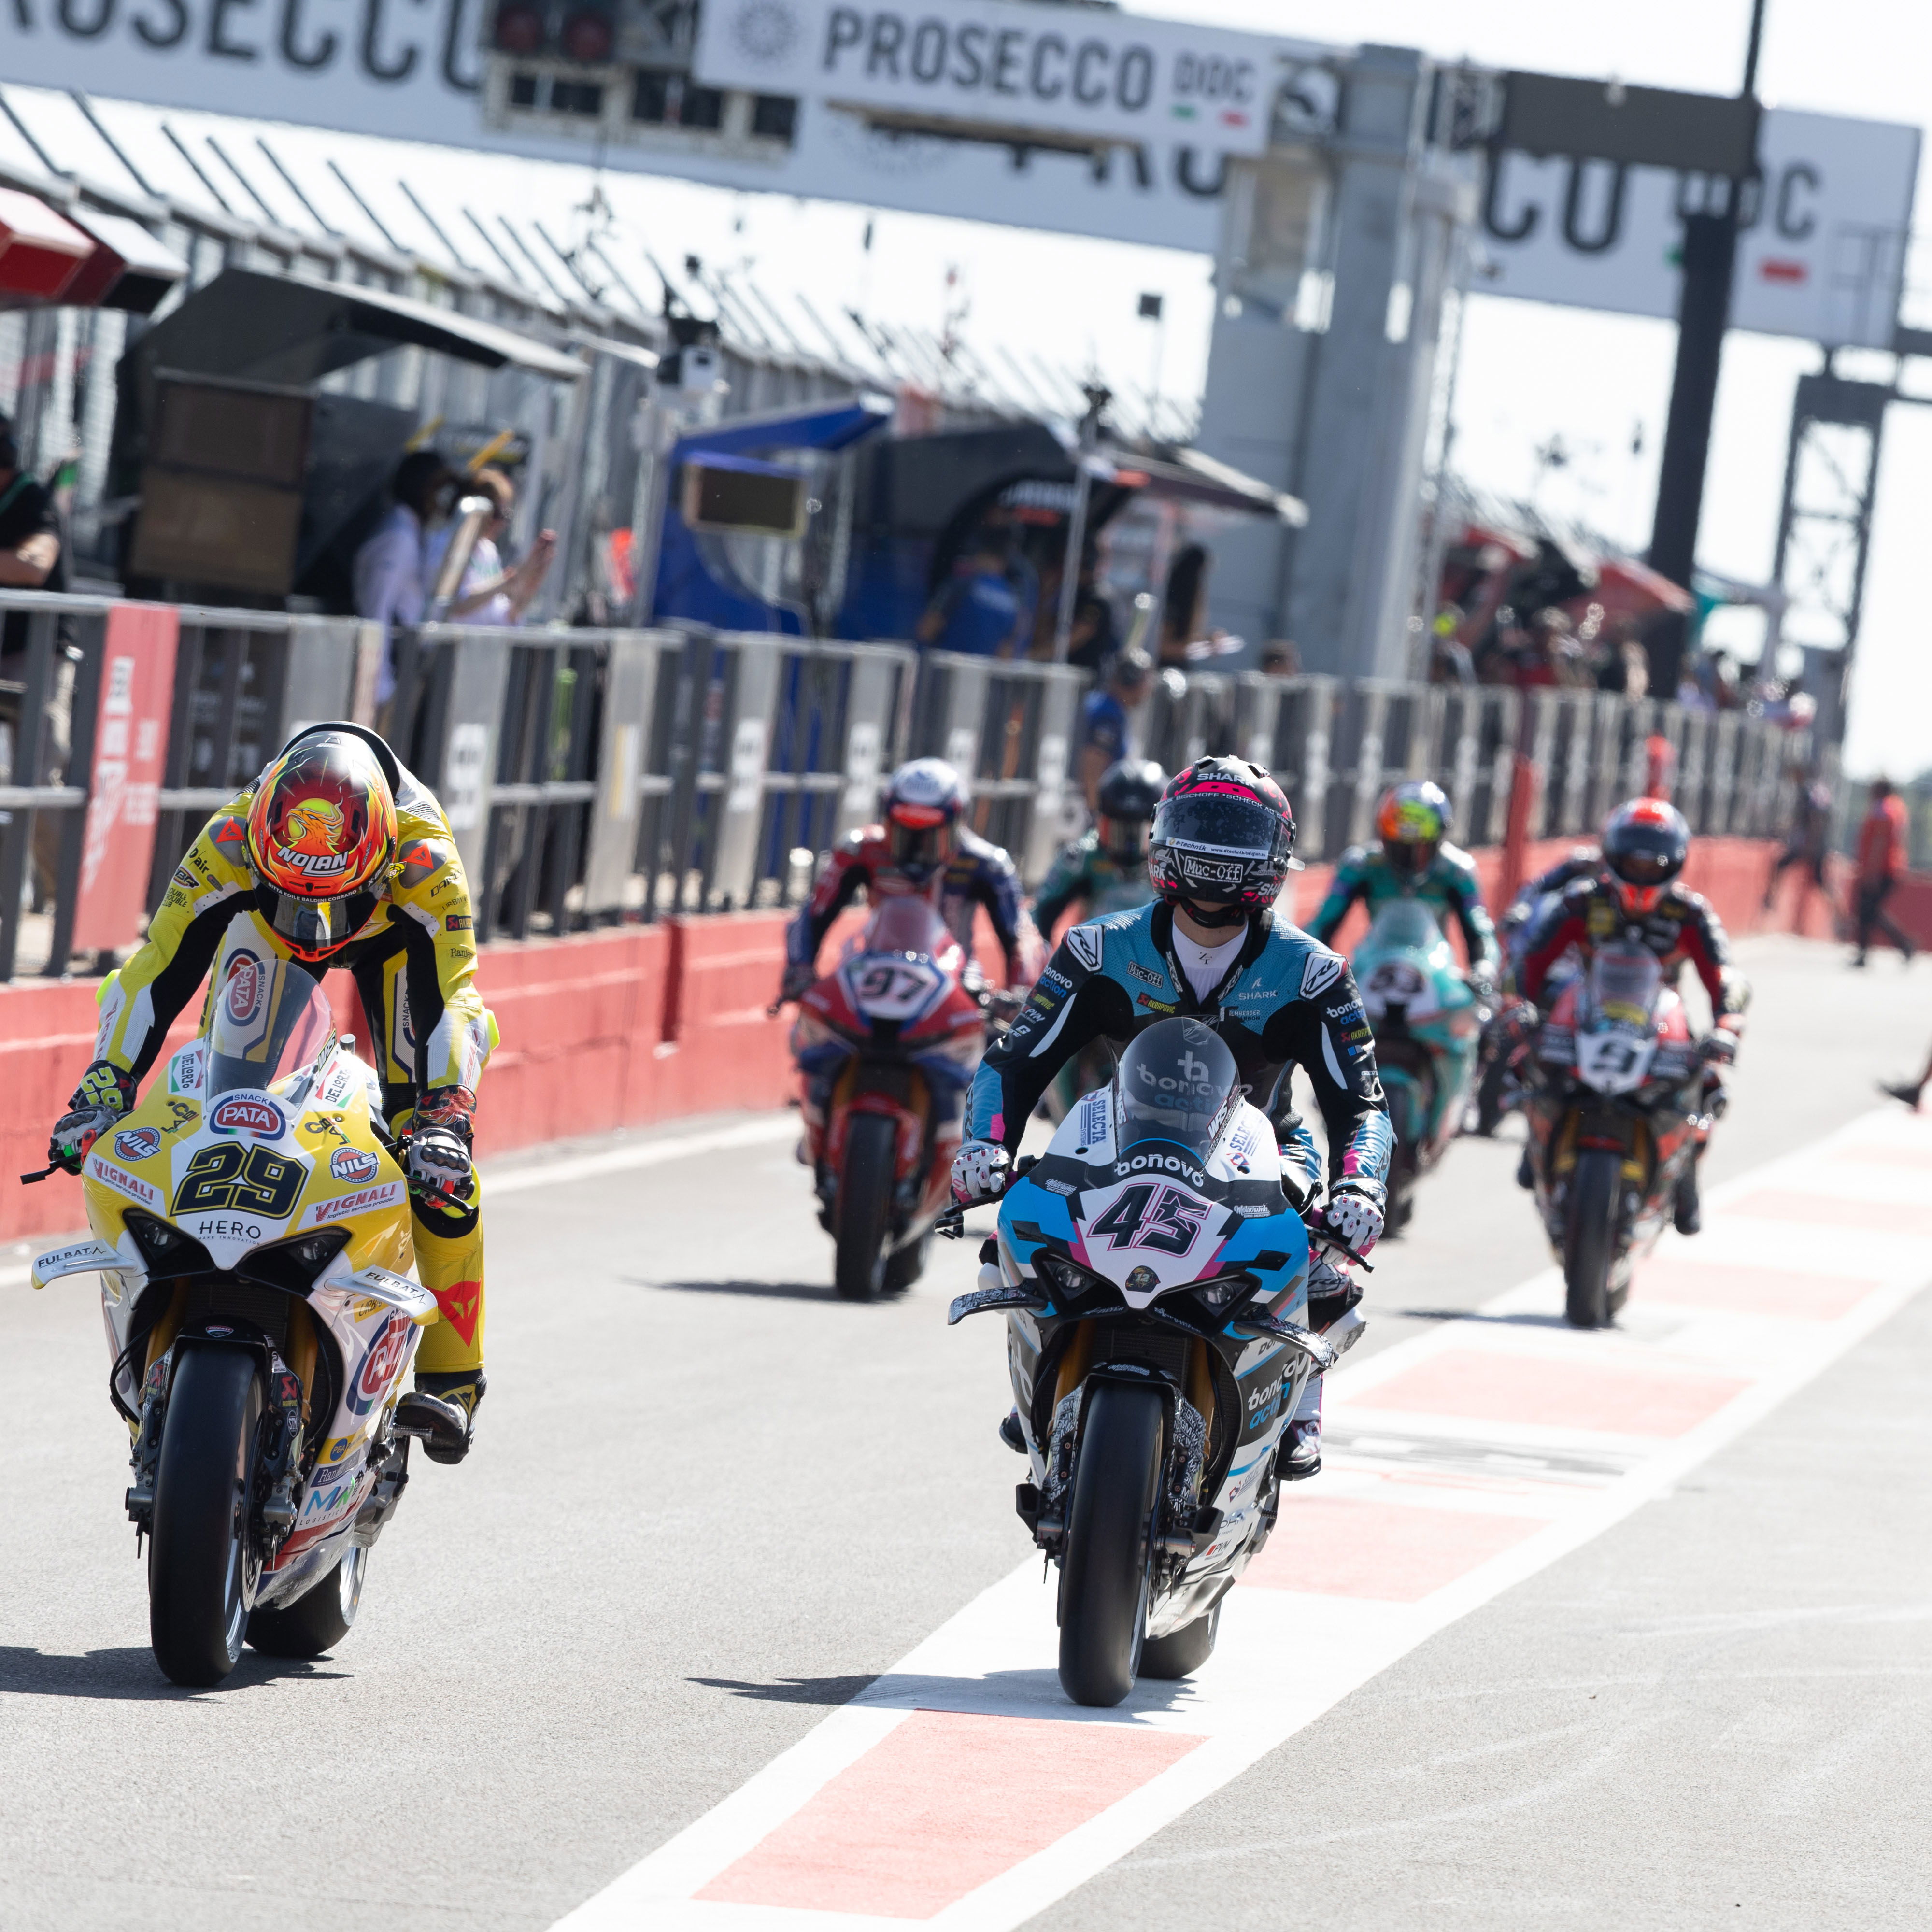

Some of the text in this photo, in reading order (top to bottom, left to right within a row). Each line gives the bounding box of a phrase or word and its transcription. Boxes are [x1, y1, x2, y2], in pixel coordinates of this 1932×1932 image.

[822, 6, 1257, 112] PROSECCO DOC
[1196, 772, 1256, 788] SHARK
[277, 846, 349, 878] NOLAN
[1186, 859, 1241, 881] Muc-Off
[268, 882, 284, 895] DITTA
[284, 892, 301, 902] EDILE
[328, 889, 357, 902] CORRADO
[256, 973, 265, 1007] SNACK
[1238, 990, 1279, 1001] SHARK
[232, 1094, 270, 1104] SNACK
[222, 1106, 270, 1128] PATA
[1092, 1099, 1107, 1144] SELECTA
[114, 1131, 161, 1158] NILS
[93, 1157, 154, 1200] VIGNALI
[331, 1152, 379, 1179] NILS
[1114, 1153, 1204, 1187] bonovo
[169, 1141, 309, 1220] 29
[316, 1184, 397, 1222] VIGNALI
[327, 1197, 395, 1219] logistic service provider
[199, 1220, 262, 1240] HERO
[1086, 1183, 1213, 1258] 45
[38, 1246, 91, 1268] FULBAT
[364, 1271, 419, 1294] FULBAT
